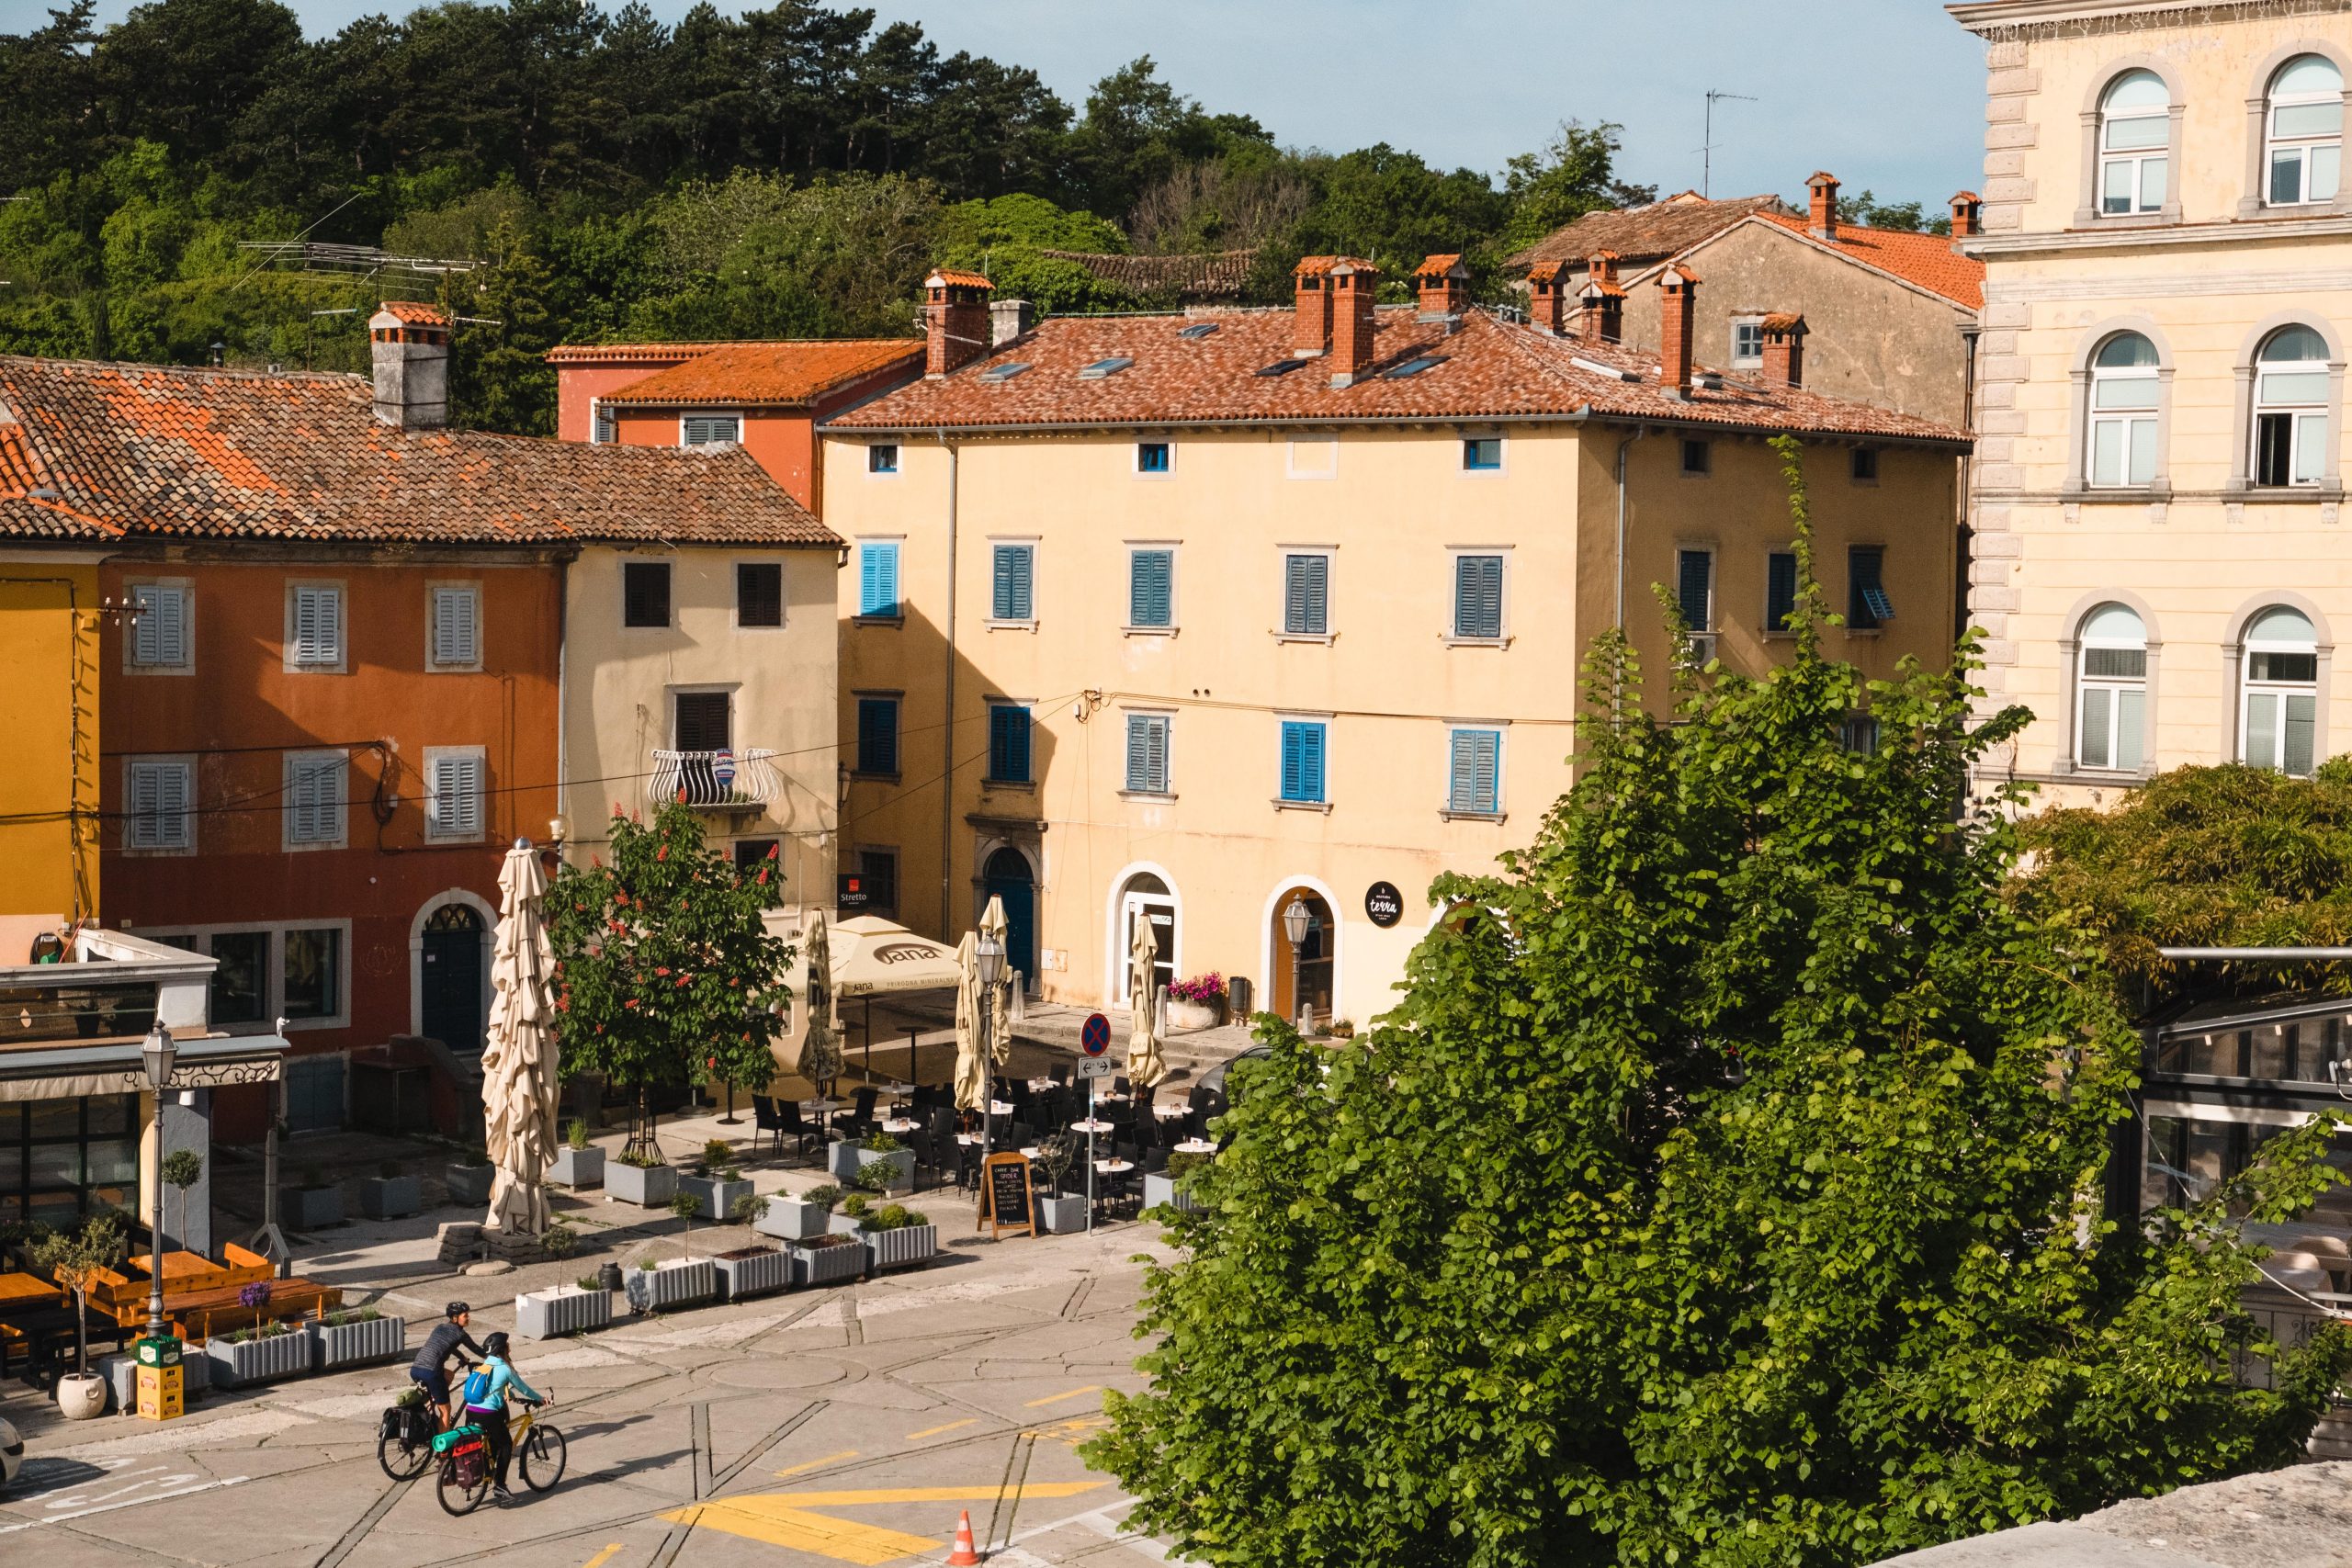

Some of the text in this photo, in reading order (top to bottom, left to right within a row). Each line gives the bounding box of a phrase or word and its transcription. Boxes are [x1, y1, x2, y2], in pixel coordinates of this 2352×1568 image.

[841, 893, 867, 901] Stretto
[1370, 898, 1396, 913] terra
[920, 976, 955, 985] MINERALNA
